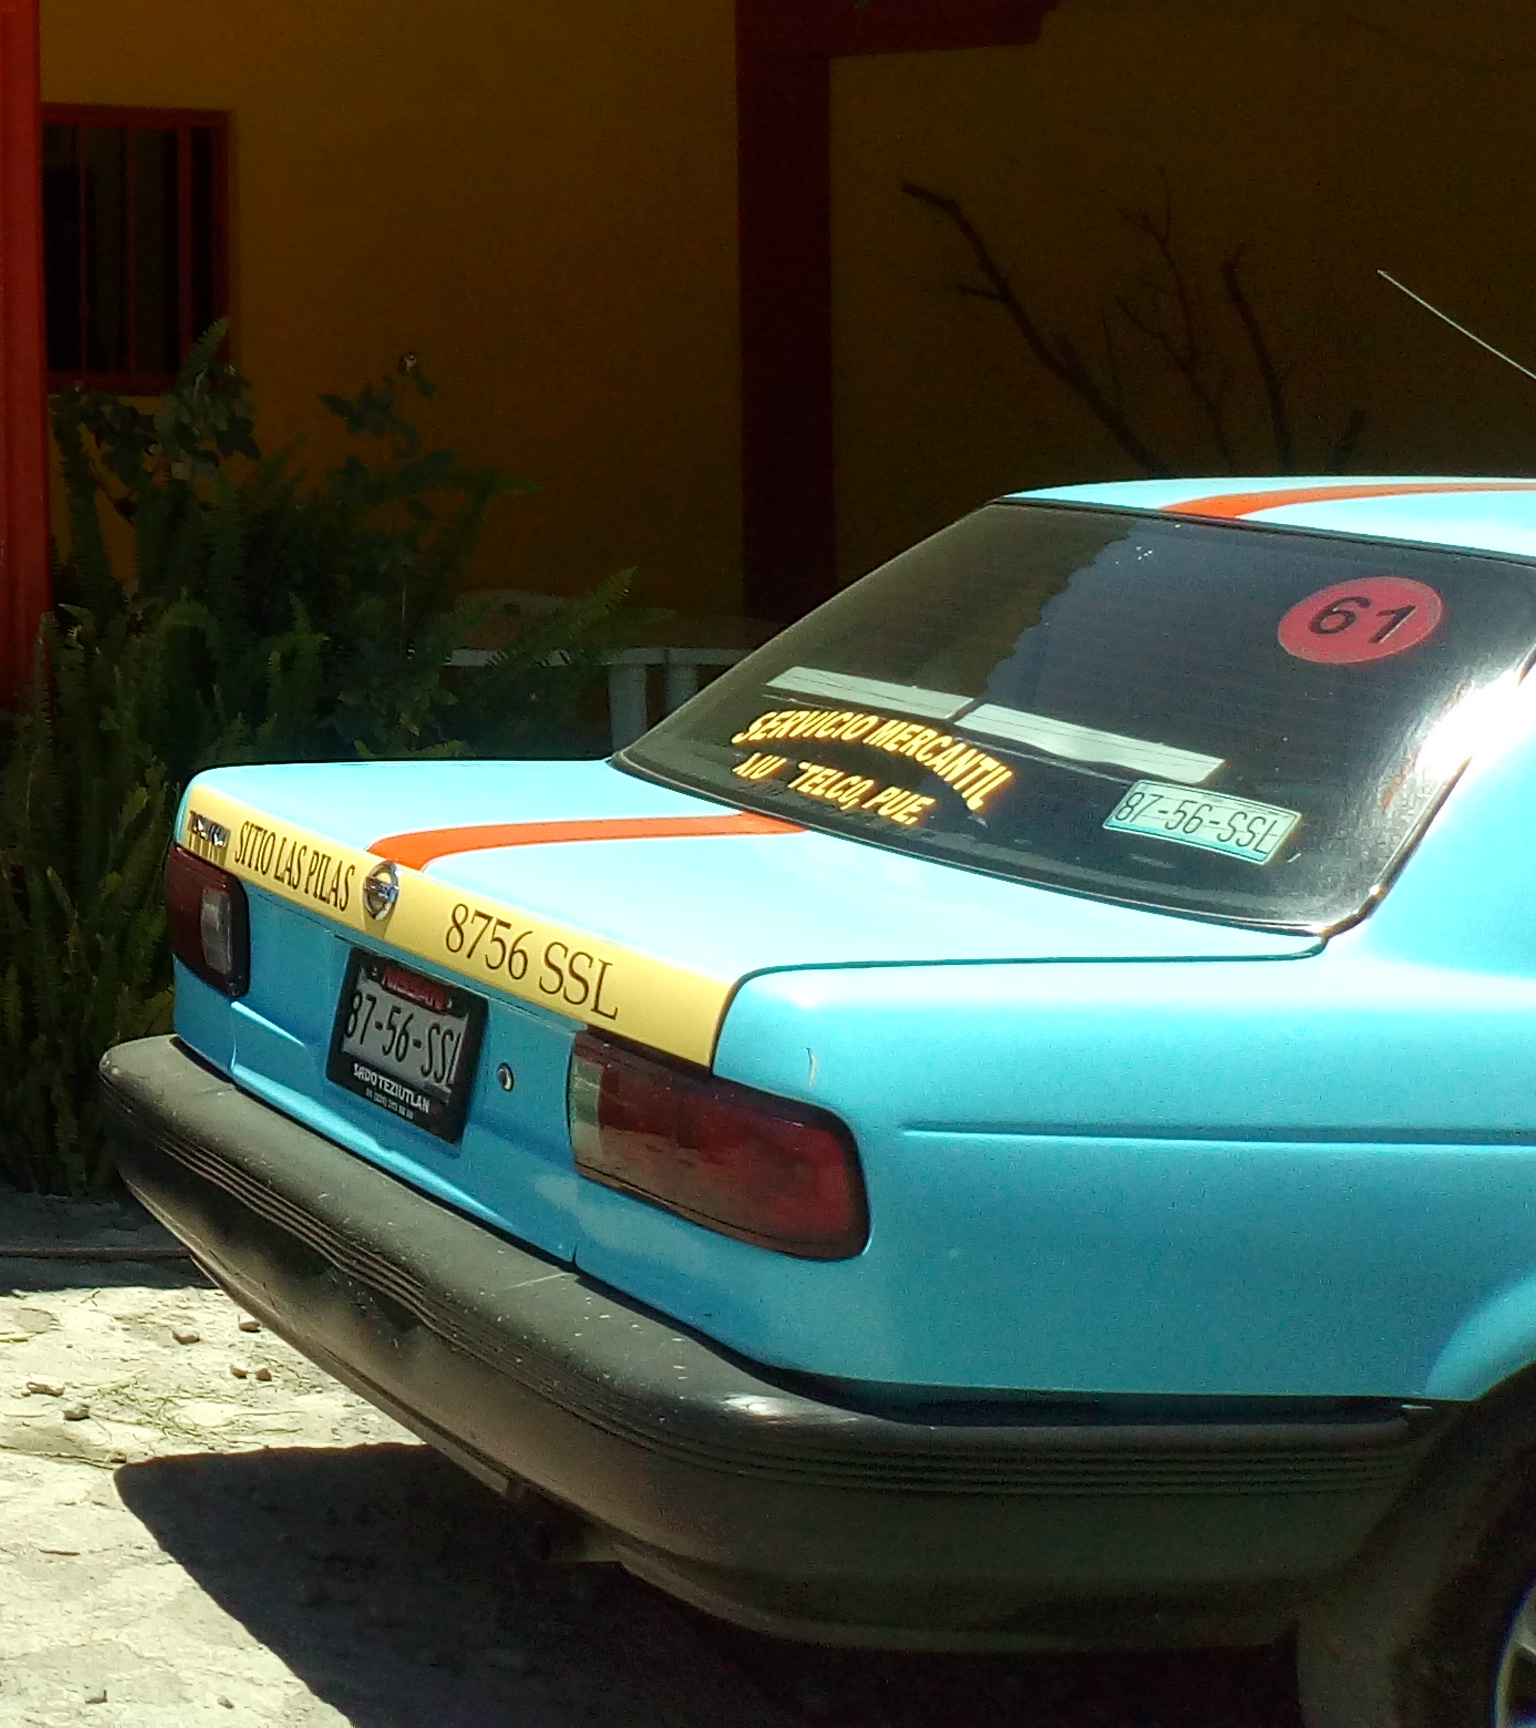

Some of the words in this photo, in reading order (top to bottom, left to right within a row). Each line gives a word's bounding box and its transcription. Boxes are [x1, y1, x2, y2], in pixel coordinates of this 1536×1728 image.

[1309, 596, 1416, 643] 61
[731, 710, 879, 745] SERVICIO
[863, 718, 1013, 811] MERCANTIL
[1115, 791, 1278, 855] 87-56-SSL
[234, 820, 276, 876] SITIO
[274, 836, 307, 890] LAS
[304, 849, 355, 912] PILAS
[446, 903, 533, 980] 8756
[539, 941, 618, 1021] SSL
[377, 1074, 431, 1114] TEZIUTLAN
